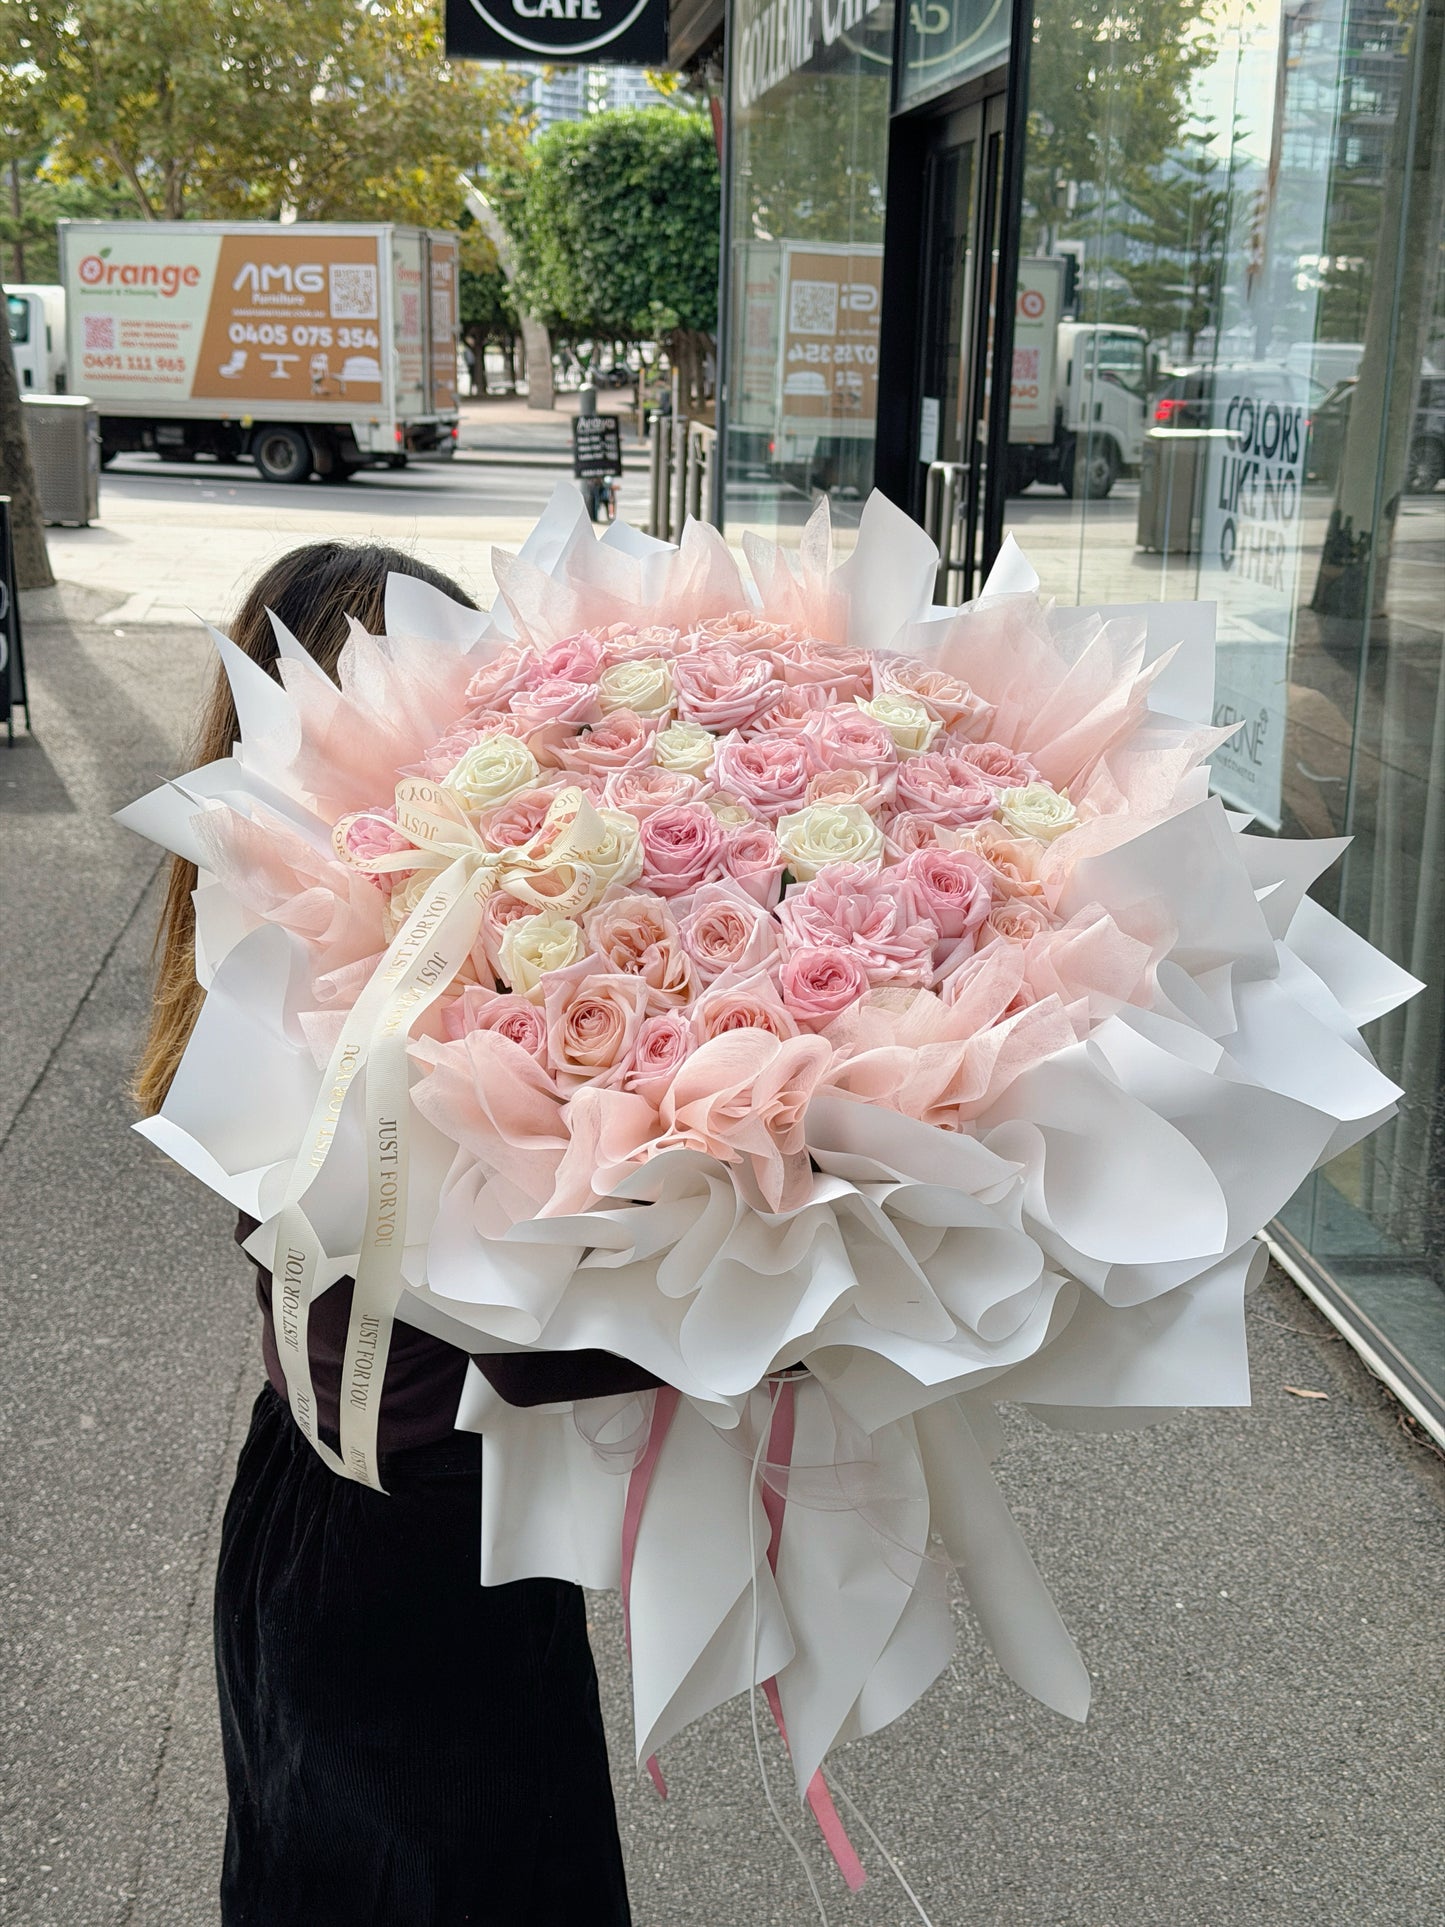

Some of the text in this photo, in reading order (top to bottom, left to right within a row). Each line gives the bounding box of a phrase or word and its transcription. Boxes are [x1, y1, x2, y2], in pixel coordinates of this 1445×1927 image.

[79, 254, 201, 298] Orange
[232, 262, 325, 293] AMG
[229, 322, 379, 349] 0405 075 354
[1226, 395, 1302, 465] COLORS
[1219, 455, 1296, 528] LIKE NO
[1220, 517, 1285, 593] OTHER
[402, 813, 439, 841] JUST
[567, 871, 591, 906] FOR
[406, 920, 434, 947] FOR
[425, 891, 450, 920] YOU
[416, 951, 449, 990] JUST
[374, 1117, 398, 1248] JUST FOR YOU
[283, 1247, 306, 1353] JUST FOR YOU
[350, 1314, 380, 1412] JUST FOR YOU
